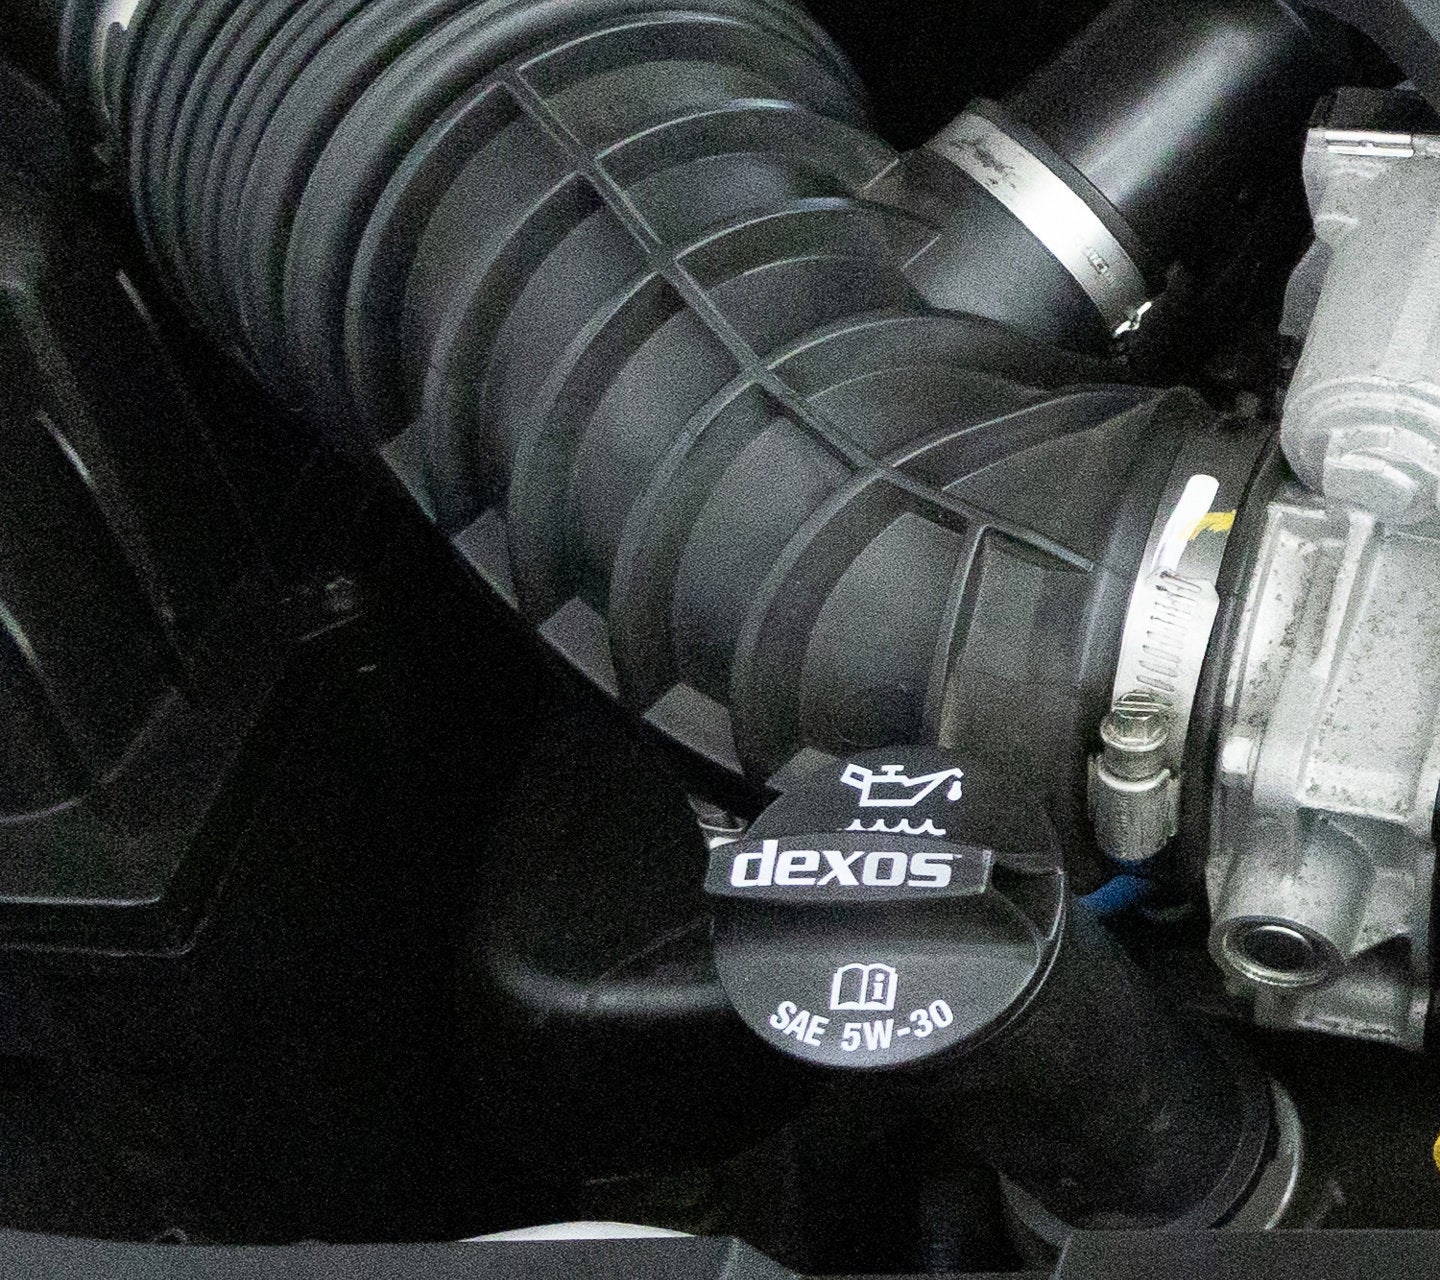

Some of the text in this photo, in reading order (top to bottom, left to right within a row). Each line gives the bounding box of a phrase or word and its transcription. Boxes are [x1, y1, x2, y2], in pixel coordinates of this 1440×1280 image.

[730, 839, 954, 888] dexos
[769, 999, 953, 1052] SAE 5W-30
